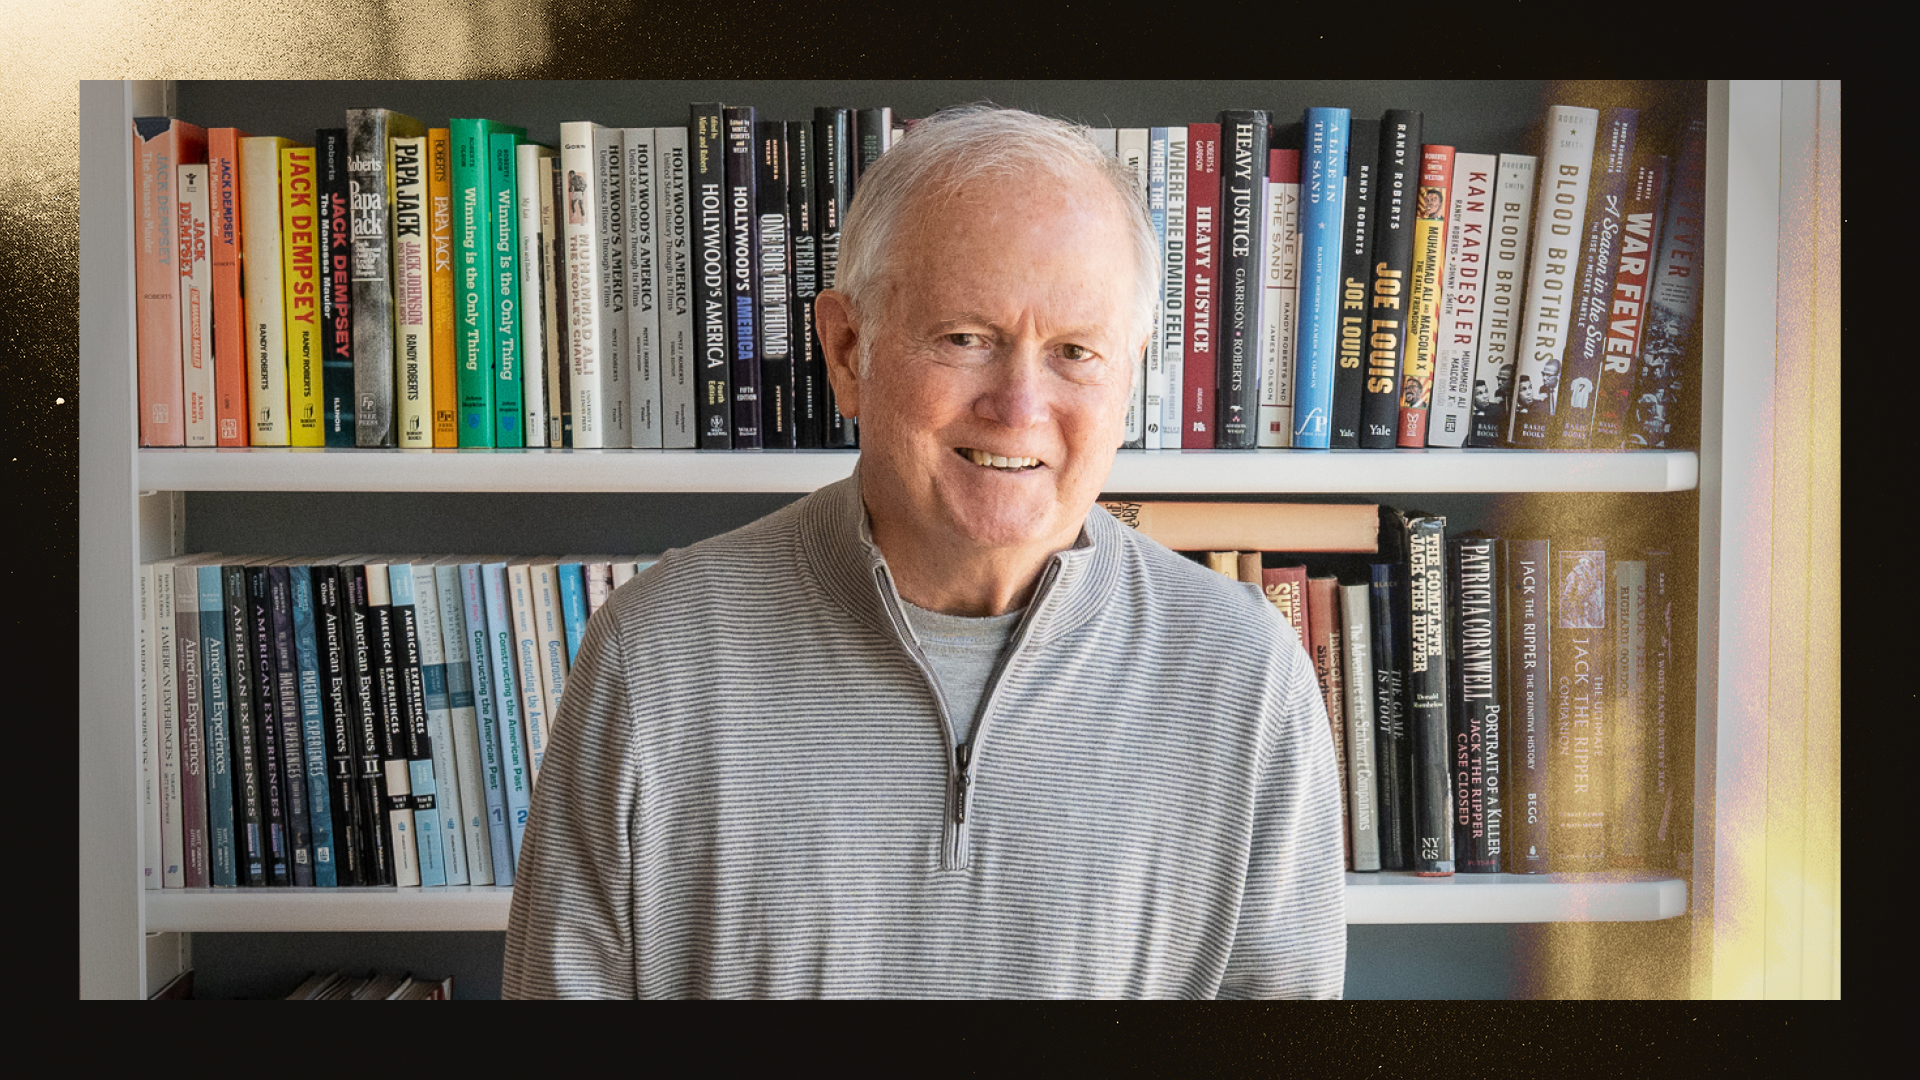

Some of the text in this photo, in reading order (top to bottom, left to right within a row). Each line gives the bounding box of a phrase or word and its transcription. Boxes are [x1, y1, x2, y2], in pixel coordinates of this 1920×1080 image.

[221, 158, 233, 245] JACK DEMPSEY
[350, 181, 382, 218] Papa
[396, 144, 421, 237] PAPA JACK
[1232, 124, 1254, 257] HEAVY JUSTICE
[1311, 121, 1324, 204] THE SAND
[1326, 123, 1338, 203] A LINE IN
[1390, 124, 1407, 230] RANDY ROBERTS
[157, 153, 170, 265] JACK DEMPSEY
[180, 202, 206, 279] JACK DEMPSEY
[289, 152, 315, 325] JACK DEMPSEY
[350, 210, 382, 243] Jack
[432, 234, 451, 272] JACK
[434, 196, 450, 231] PAPA
[608, 145, 624, 312] HOLLYWOOD'S AMERICA
[1165, 141, 1186, 349] WHERE THE DOMINO FELL
[1424, 226, 1438, 283] MUHAMMAD
[333, 192, 349, 358] JACK DEMPSEY
[406, 242, 423, 326] JACK JOHNSON
[463, 187, 478, 370] Winning is the Only Thing
[496, 189, 514, 380] Winning Is the Only Thing
[701, 183, 724, 368] HOLLYWOOD'S AMERICA
[734, 186, 754, 360] HOLLYWOOD'S AMERICA
[760, 213, 789, 355] ONE FOR THE THUMB
[795, 202, 816, 361] THE STEELERS READER
[1193, 206, 1212, 353] HEAVY JUSTICE
[1422, 285, 1433, 302] ALI
[1453, 172, 1488, 344] KAN KARDEŞLER
[1488, 203, 1521, 364] BLOOD BROTHERS
[1534, 165, 1580, 362] BLOOD BROTHERS
[1583, 195, 1621, 360] A Season in the Sun
[1605, 212, 1653, 373] WAR FEVER
[570, 235, 583, 375] THE PEOPLE'S CHAMP
[579, 234, 595, 375] MUHAMMAD ALI
[1231, 268, 1246, 391] GARRISON ROBERTS
[1340, 277, 1365, 368] JOE LOUIS
[1368, 262, 1402, 394] JOE LOUIS
[1417, 314, 1431, 360] MALCOLM
[406, 334, 419, 401] RANDY ROBERTS
[708, 380, 717, 405] Edition
[717, 381, 725, 403] Fourth
[1369, 425, 1391, 437] Yale
[1292, 581, 1303, 624] MICHAEL
[1351, 624, 1363, 641] The
[1410, 534, 1428, 672] JACK THE RIPPER
[1426, 534, 1442, 656] THE COMPLETE
[1460, 545, 1493, 702] PATRICIA CORNWELL
[1520, 561, 1537, 669] JACK THE RIPPER
[326, 613, 348, 752] American Experiences
[404, 610, 425, 734] AMERICAN EXPERIENCES
[498, 632, 513, 697] Constructing
[1352, 643, 1367, 694] Adventure
[1378, 669, 1391, 684] IS
[1619, 586, 1630, 698] RICHARD GORDON
[209, 637, 228, 774] American Experiences
[233, 605, 256, 817] AMERICAN EXPERIENCES
[279, 672, 295, 718] AMERICAN
[474, 630, 499, 790] Constructing the American Past
[504, 700, 514, 717] the
[1355, 704, 1366, 719] the
[1378, 687, 1392, 734] AFOOT
[1392, 669, 1405, 740] THE GAME
[1559, 676, 1570, 755] COMPANION
[1572, 638, 1589, 794] JACK THE RIPPER
[1594, 676, 1603, 757] THE ULTIMATE
[284, 722, 301, 778] EXPERIENCES
[506, 718, 521, 765] American
[511, 768, 524, 792] Past
[1354, 720, 1369, 768] Stalwart
[1457, 733, 1471, 825] CASE CLOSED
[1470, 718, 1484, 839] JACK THE RIPPER
[1485, 704, 1501, 856] PORTRAIT OF A KILLER
[1357, 770, 1374, 830] Companions
[1421, 837, 1439, 848] NY
[1527, 793, 1538, 824] BEGG
[1421, 849, 1439, 860] GS
